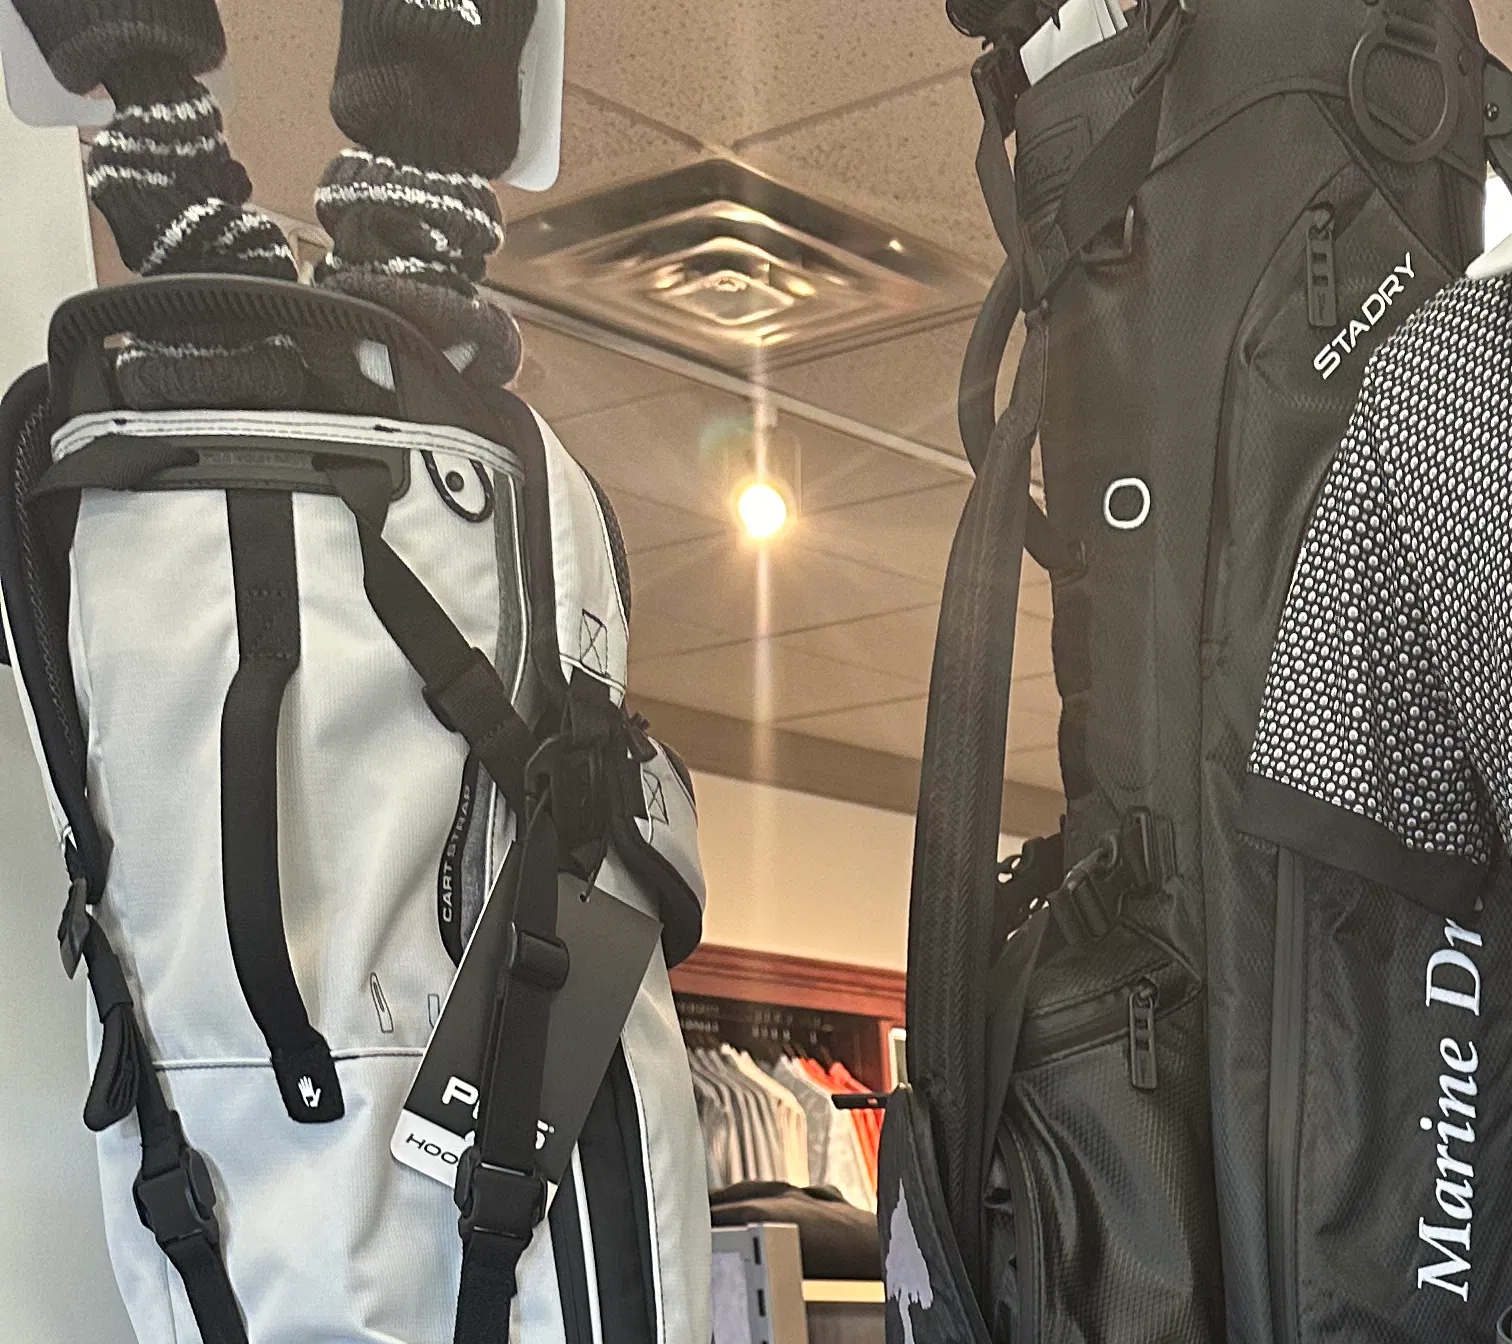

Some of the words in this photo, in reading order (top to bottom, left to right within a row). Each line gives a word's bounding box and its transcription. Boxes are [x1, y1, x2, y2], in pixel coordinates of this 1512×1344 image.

[1313, 251, 1415, 380] STADRY
[447, 784, 471, 858] STRAP
[442, 862, 454, 923] CART
[405, 1133, 459, 1165] HOO
[1416, 1036, 1481, 1302] Marine
